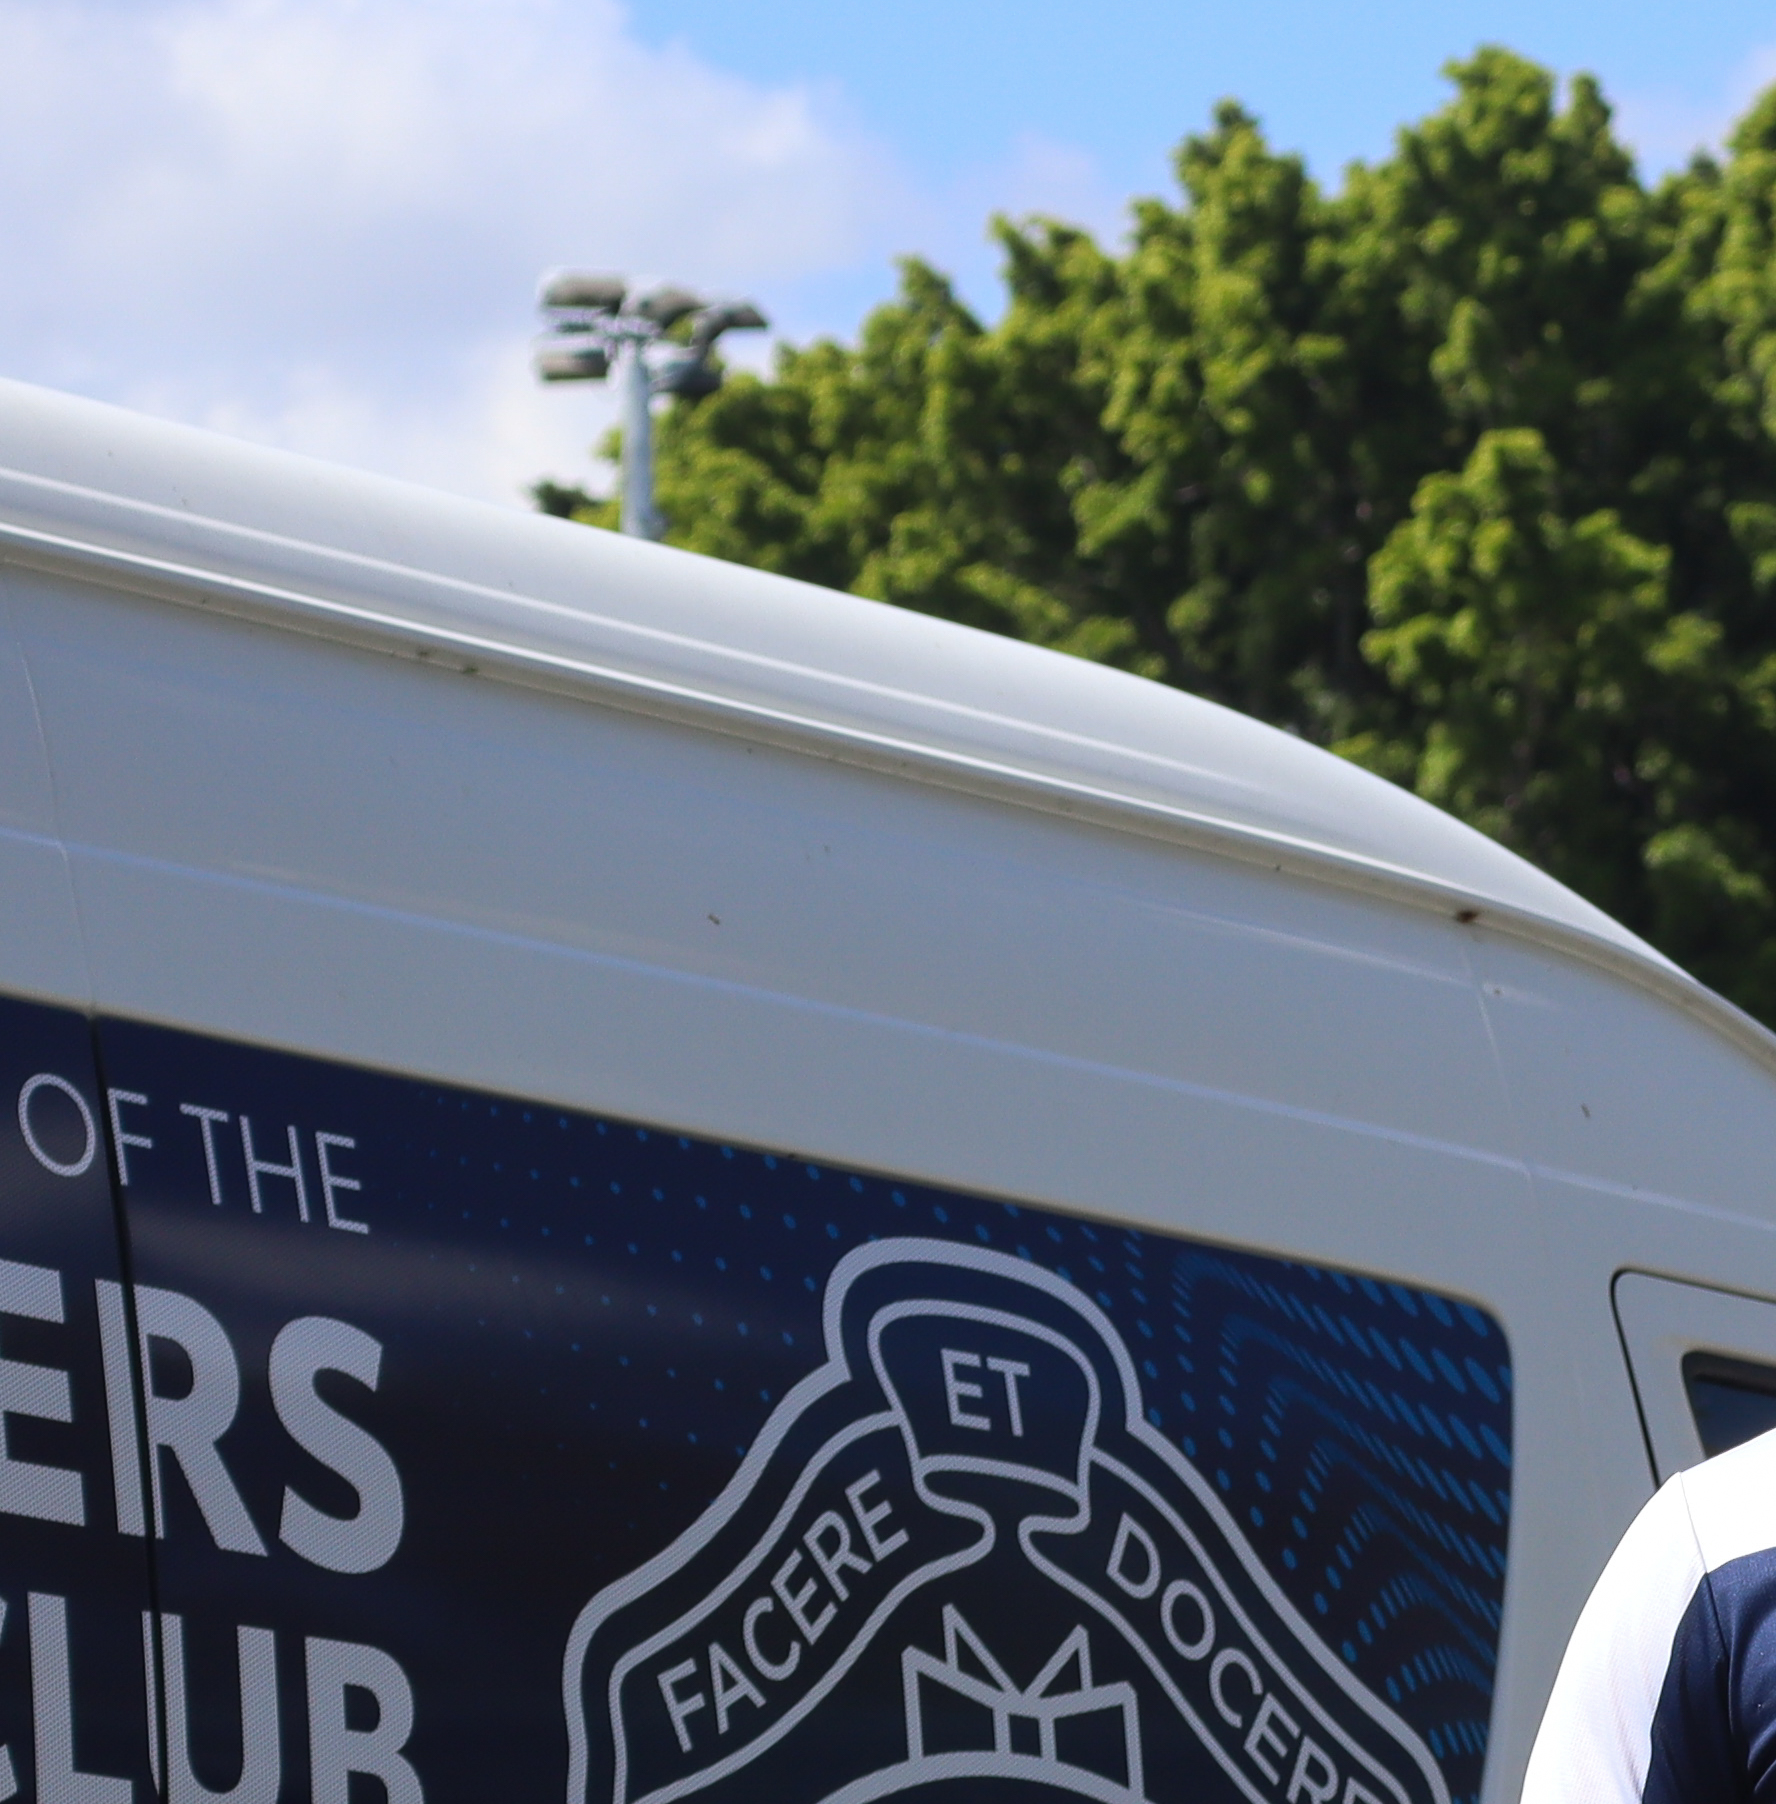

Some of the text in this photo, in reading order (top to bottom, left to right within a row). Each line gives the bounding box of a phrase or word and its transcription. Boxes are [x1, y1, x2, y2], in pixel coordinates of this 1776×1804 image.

[17, 1073, 368, 1234] OF THE
[940, 1348, 1030, 1437] ET
[657, 1469, 909, 1752] FACERE
